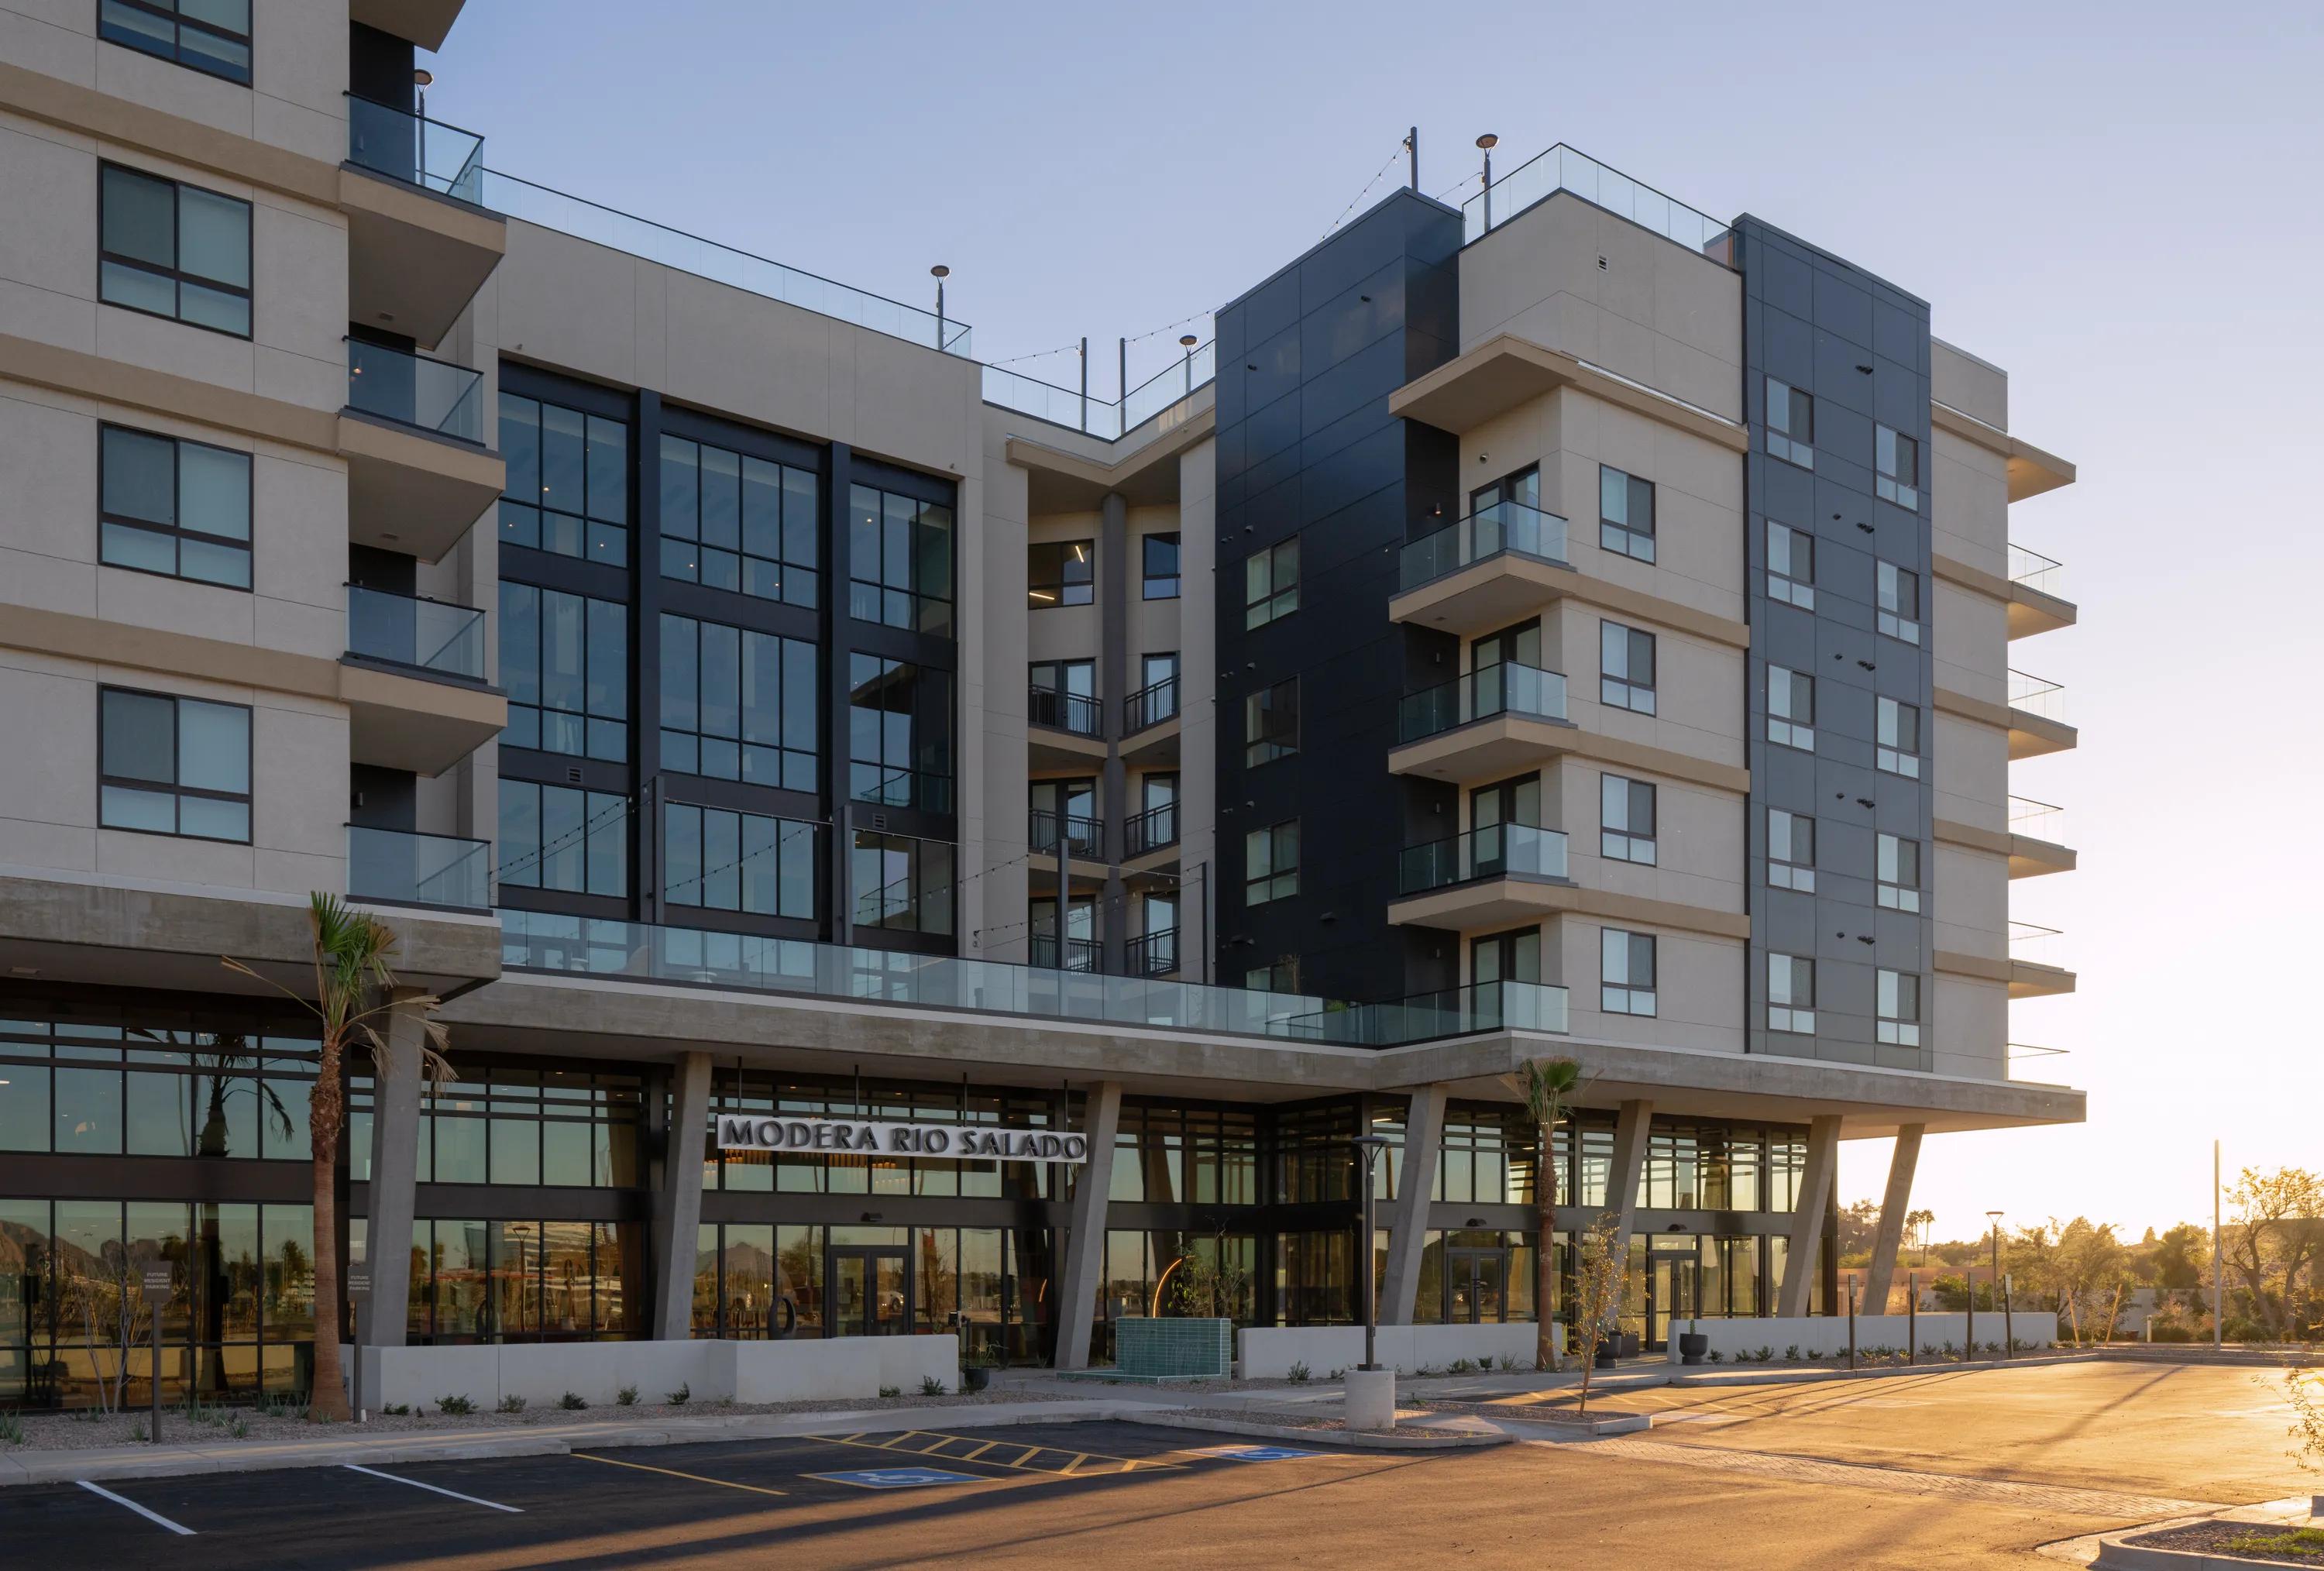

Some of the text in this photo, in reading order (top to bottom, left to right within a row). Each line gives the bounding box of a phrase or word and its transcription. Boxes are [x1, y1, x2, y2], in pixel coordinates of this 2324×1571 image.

[725, 1119, 1086, 1159] MODERA RIO SALADO
